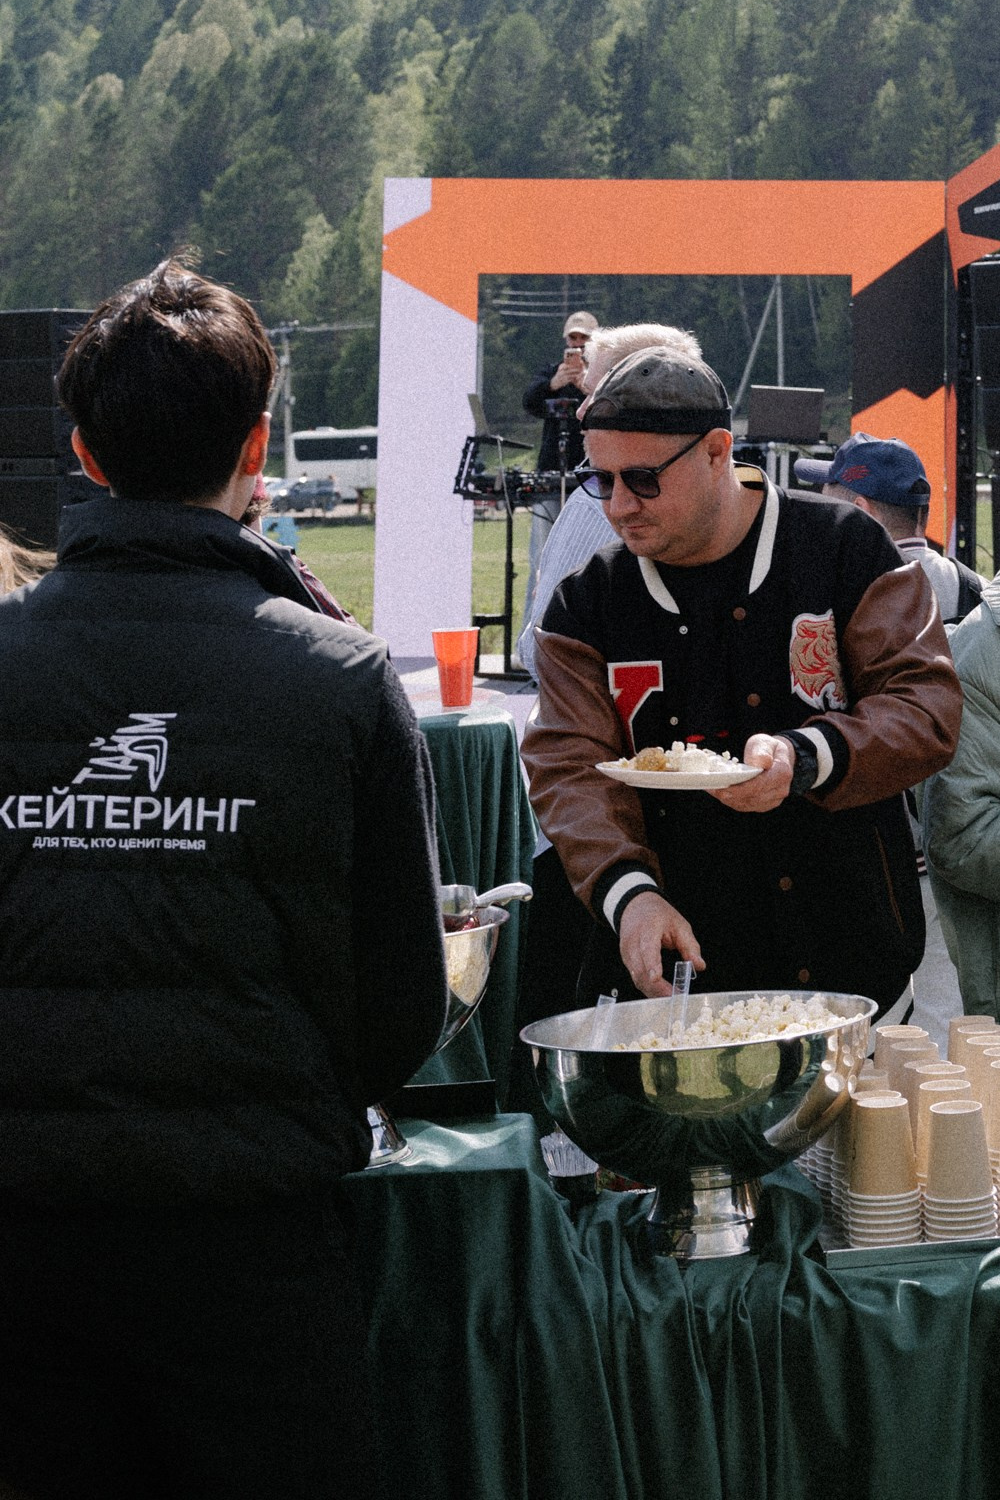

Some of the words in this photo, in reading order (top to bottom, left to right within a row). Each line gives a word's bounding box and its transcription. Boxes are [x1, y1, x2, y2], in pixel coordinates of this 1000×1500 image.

[32, 836, 59, 849] ДЛЯ
[61, 836, 89, 850] ТЕХ,
[91, 837, 116, 848] КТО
[118, 837, 162, 850] ЦЕНИТ
[163, 838, 206, 850] ВРЕМЯ
